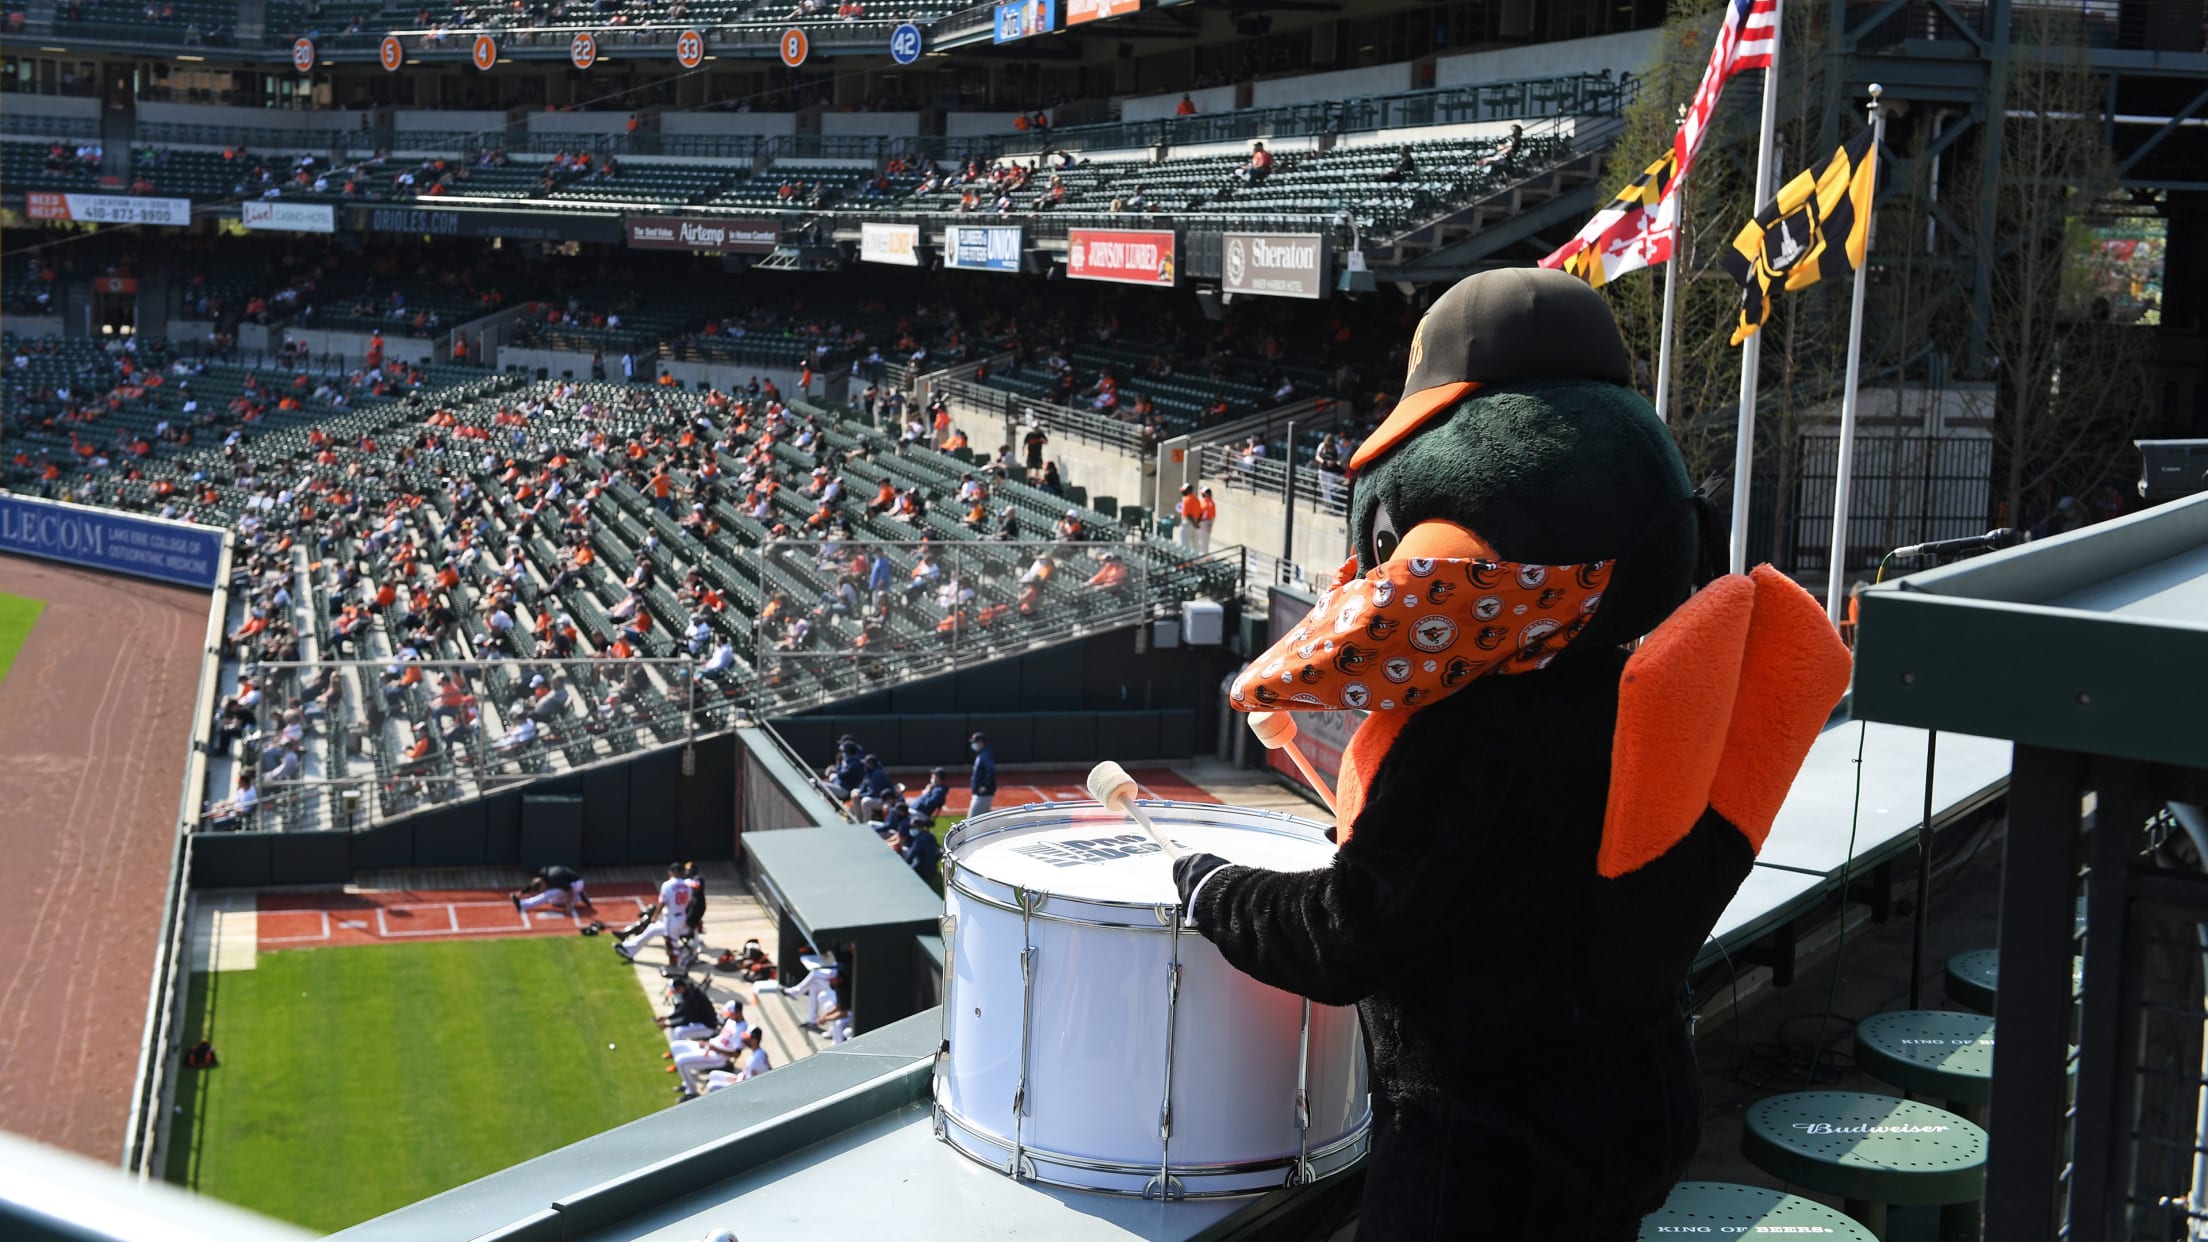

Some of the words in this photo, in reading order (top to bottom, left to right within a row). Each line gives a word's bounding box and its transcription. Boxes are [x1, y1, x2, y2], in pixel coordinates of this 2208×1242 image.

[295, 45, 309, 64] 20
[386, 44, 394, 61] 5
[479, 43, 487, 61] 4
[575, 40, 591, 60] 22
[680, 39, 697, 59] 33
[788, 37, 798, 58] 8
[894, 33, 916, 55] 42
[30, 194, 59, 206] NEED
[30, 207, 65, 218] HELP?
[245, 203, 273, 224] Live!
[373, 210, 458, 233] ORIOLES.COM
[679, 222, 725, 246] Airtemp
[988, 229, 1020, 261] UNION
[1252, 238, 1314, 269] Sheraton
[108, 527, 129, 542] LAKE
[150, 534, 187, 552] COLLEGE
[189, 541, 200, 554] OF
[166, 554, 207, 575] MEDICINE
[1792, 1123, 1950, 1135] Budweiser
